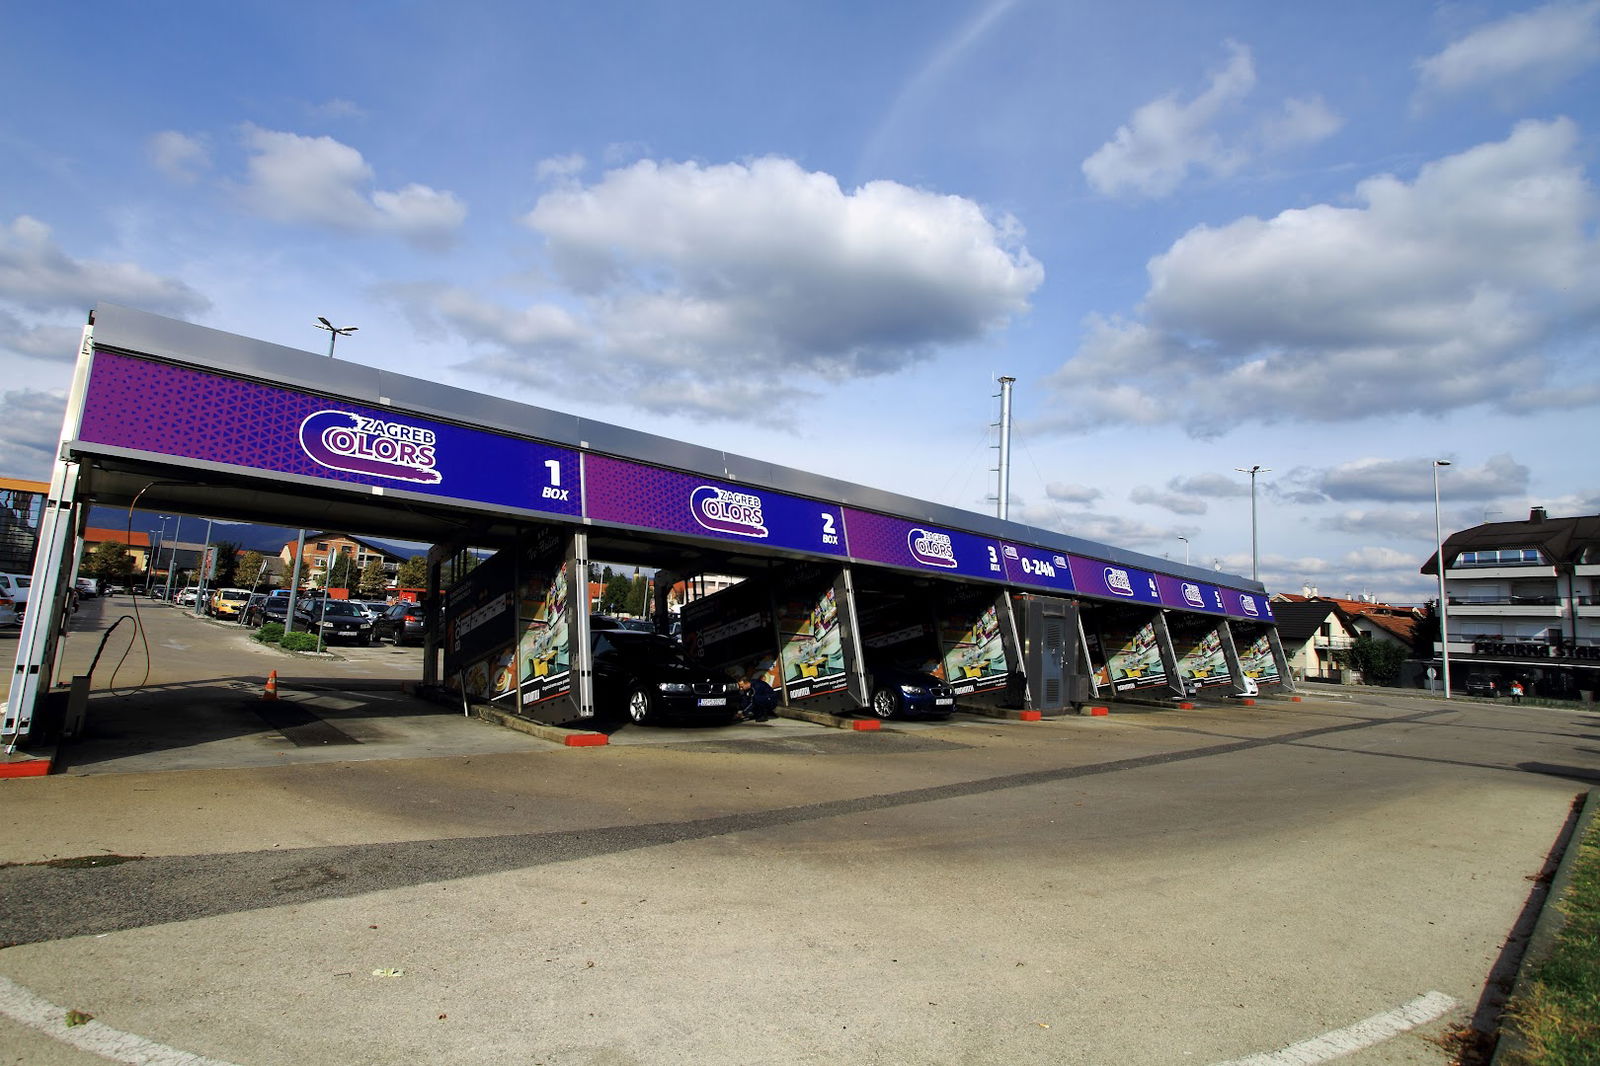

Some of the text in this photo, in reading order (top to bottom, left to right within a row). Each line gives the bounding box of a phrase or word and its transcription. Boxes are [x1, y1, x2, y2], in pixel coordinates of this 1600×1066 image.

[358, 417, 436, 445] ZAGREB
[299, 411, 440, 482] COLORS
[544, 459, 560, 486] 1
[541, 486, 569, 501] BOX
[719, 490, 761, 508] ZAGREB
[821, 512, 836, 535] 2
[822, 534, 838, 545] BOX
[924, 531, 951, 545] ZAGREB
[987, 545, 998, 563] 3
[1020, 557, 1056, 577] 0-24h
